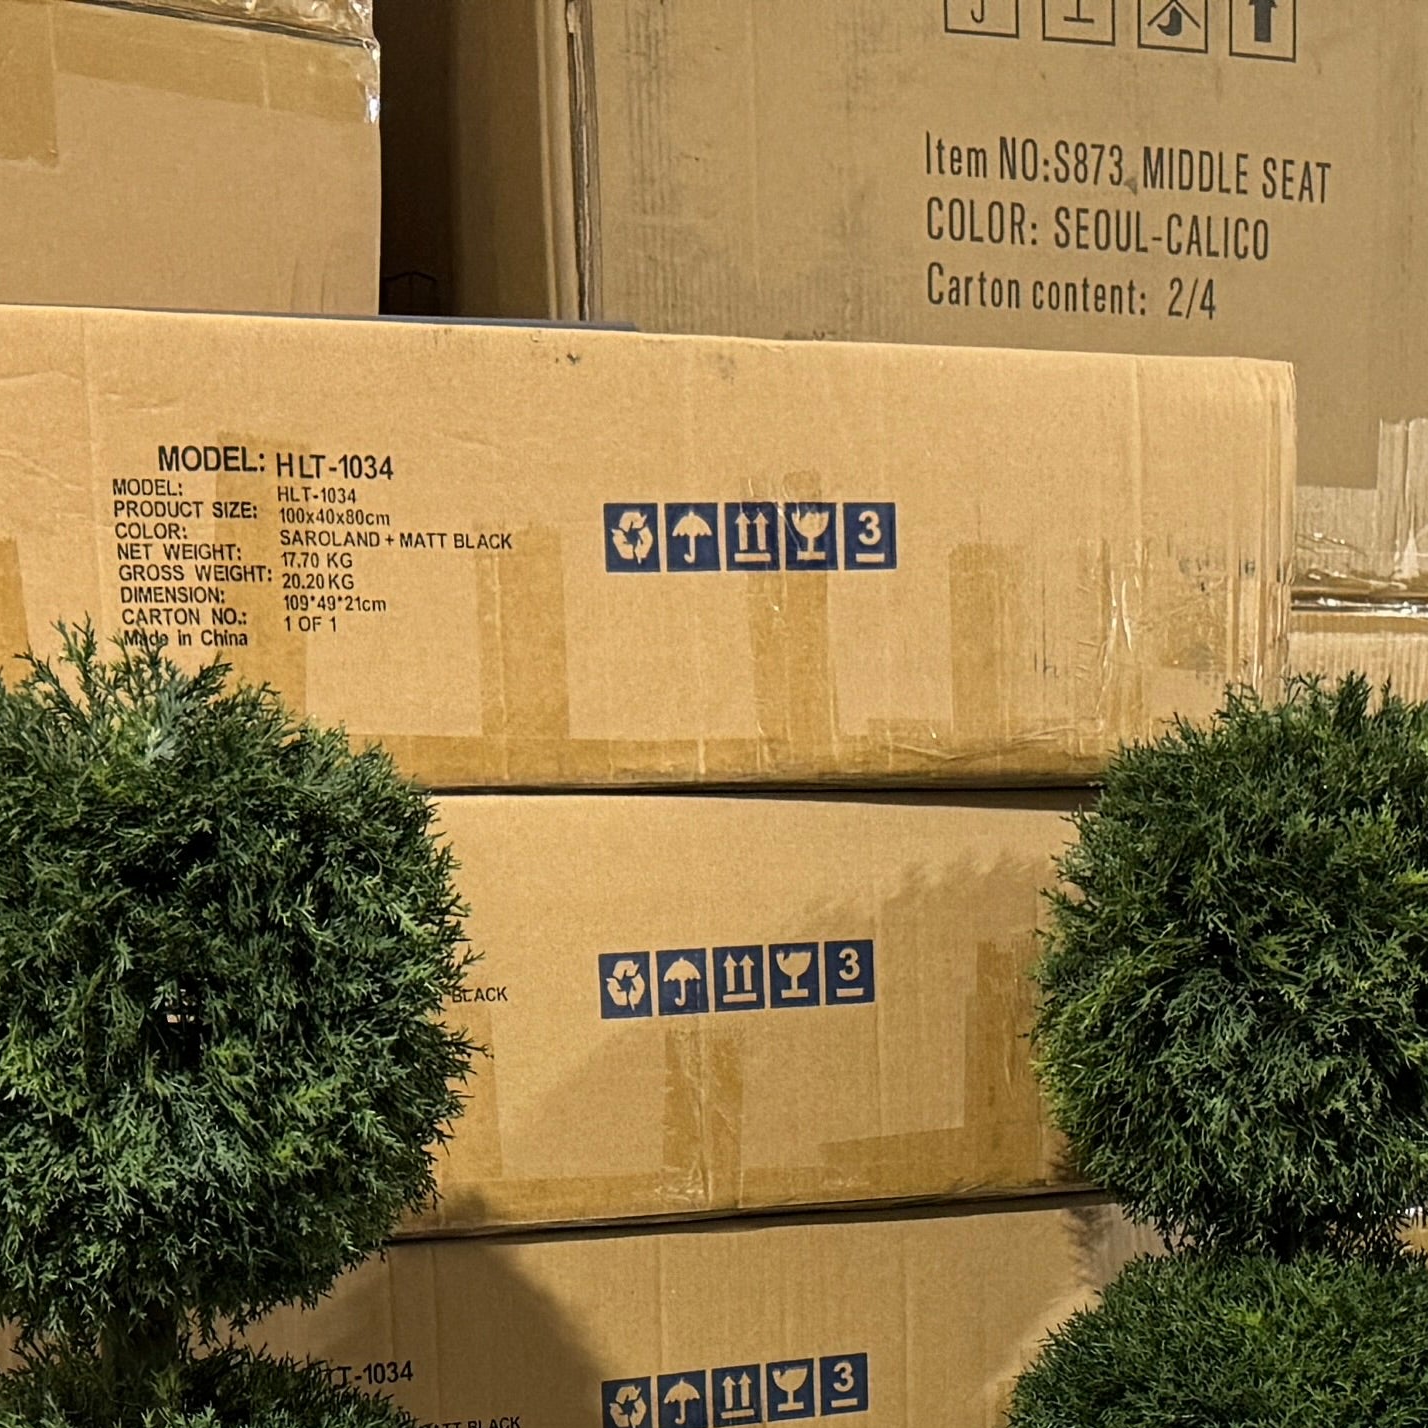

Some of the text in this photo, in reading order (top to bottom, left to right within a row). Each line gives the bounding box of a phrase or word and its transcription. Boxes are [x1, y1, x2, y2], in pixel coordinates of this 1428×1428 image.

[925, 131, 988, 179] Item
[1144, 146, 1248, 196] MIDDLE
[1263, 157, 1332, 204] SEAT
[927, 197, 1270, 261] COLOR: SEOUL-CALICO
[927, 261, 1217, 320] Carton content: 2/4
[158, 445, 394, 480] MODEL: HLT-1034
[113, 478, 356, 504] MODEL: HLT-1034
[113, 500, 390, 526] PRODUCT SIZE: 100x40x80cm
[115, 522, 188, 540] COLOR:
[280, 529, 380, 548] SAROLAND
[399, 532, 448, 549] MATT
[453, 533, 512, 550] BLACK
[858, 510, 882, 546] 3
[117, 543, 353, 569] NET WEIGHT: 17.70 KG
[118, 564, 355, 590] GROSS WEIGHT: 20.20 KG
[120, 586, 225, 604] DIMENSION:
[122, 608, 200, 626] CARTON
[284, 616, 291, 632] 1
[298, 616, 322, 632] OF
[331, 616, 337, 632] 1
[123, 629, 248, 647] Made in China
[839, 947, 860, 981] 3
[833, 1362, 855, 1394] 3
